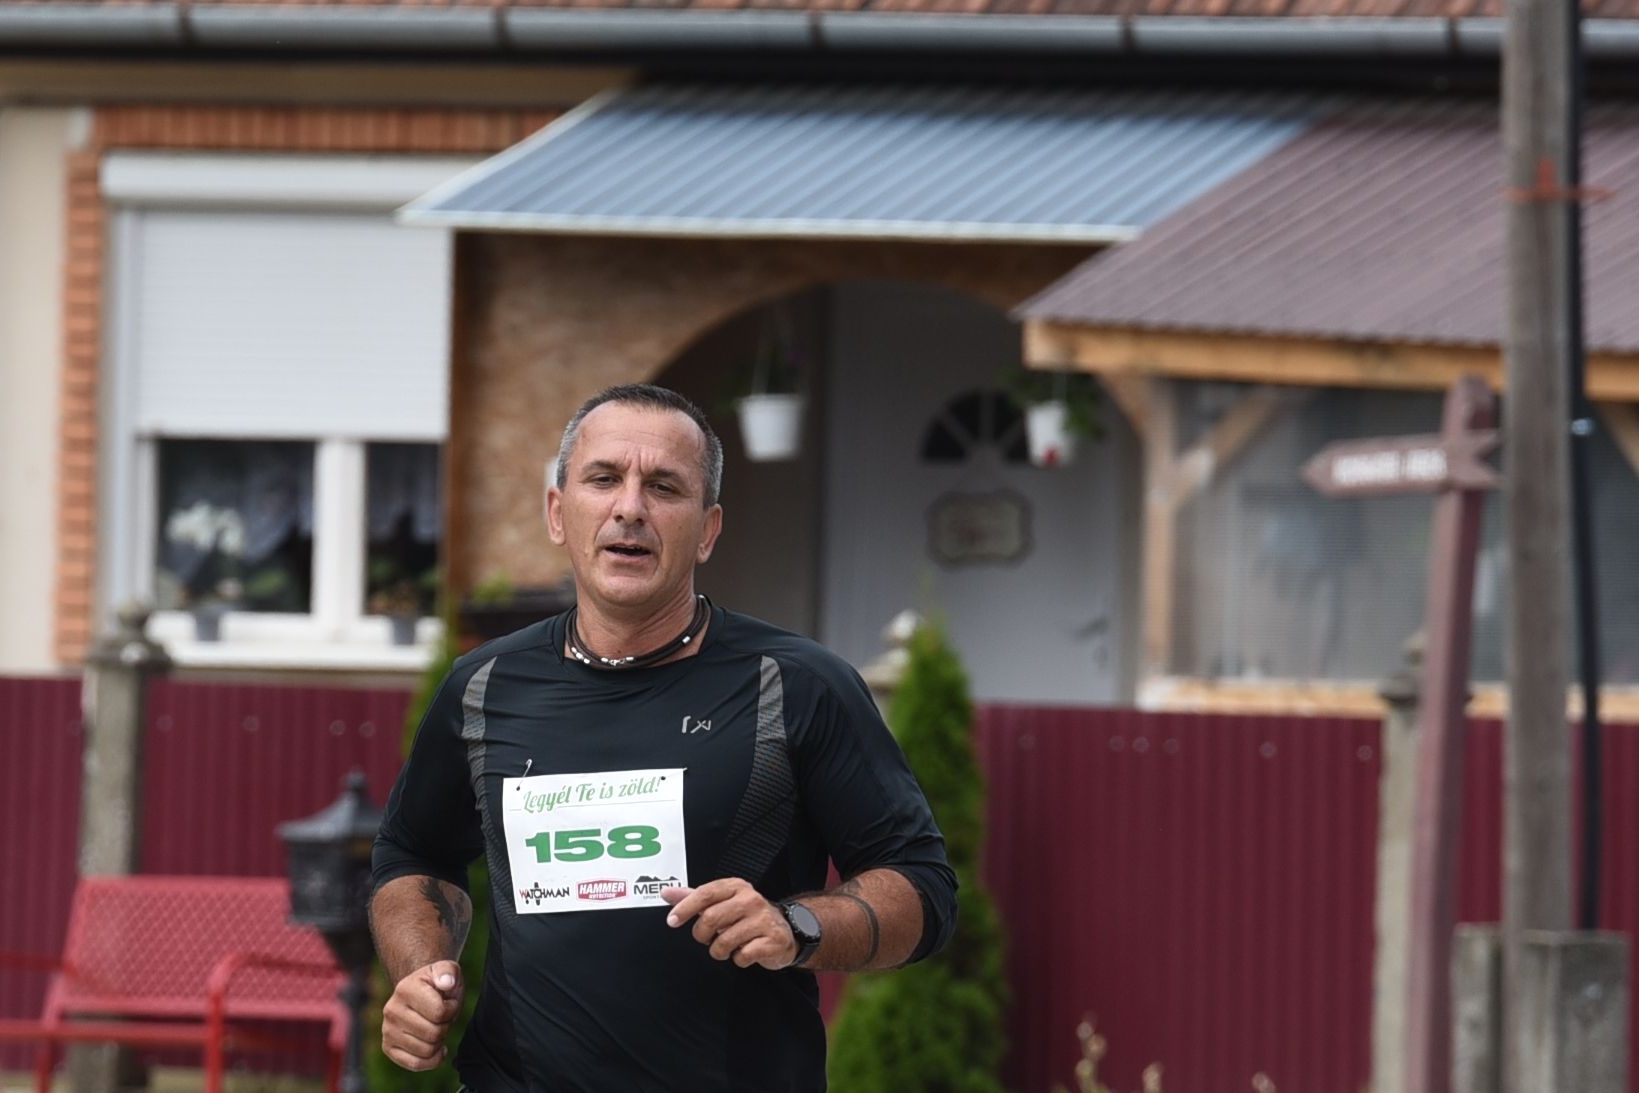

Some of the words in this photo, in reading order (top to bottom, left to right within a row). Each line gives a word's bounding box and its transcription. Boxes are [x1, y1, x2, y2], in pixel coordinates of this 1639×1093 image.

[523, 785, 572, 813] Legyél
[576, 783, 596, 802] Te
[599, 782, 614, 799] is
[618, 776, 661, 797] zöld!
[525, 825, 662, 863] 158
[519, 885, 570, 900] WATCHMAN
[579, 882, 625, 895] HAMMER
